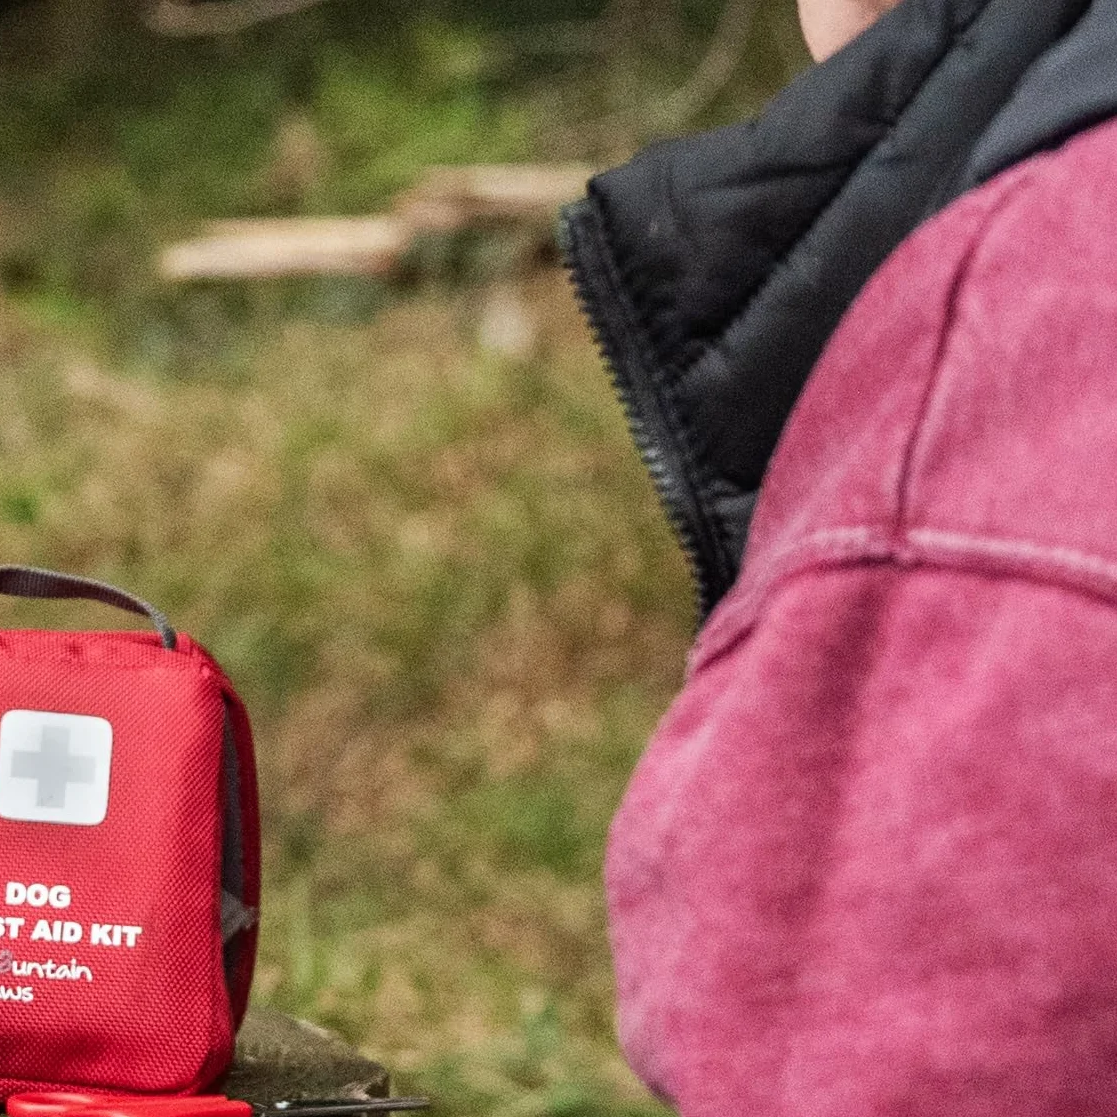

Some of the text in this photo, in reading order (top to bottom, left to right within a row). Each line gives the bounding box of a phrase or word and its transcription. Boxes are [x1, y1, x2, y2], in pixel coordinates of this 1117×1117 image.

[5, 881, 71, 908] DOG
[31, 919, 83, 943] AID
[90, 923, 143, 947] KIT
